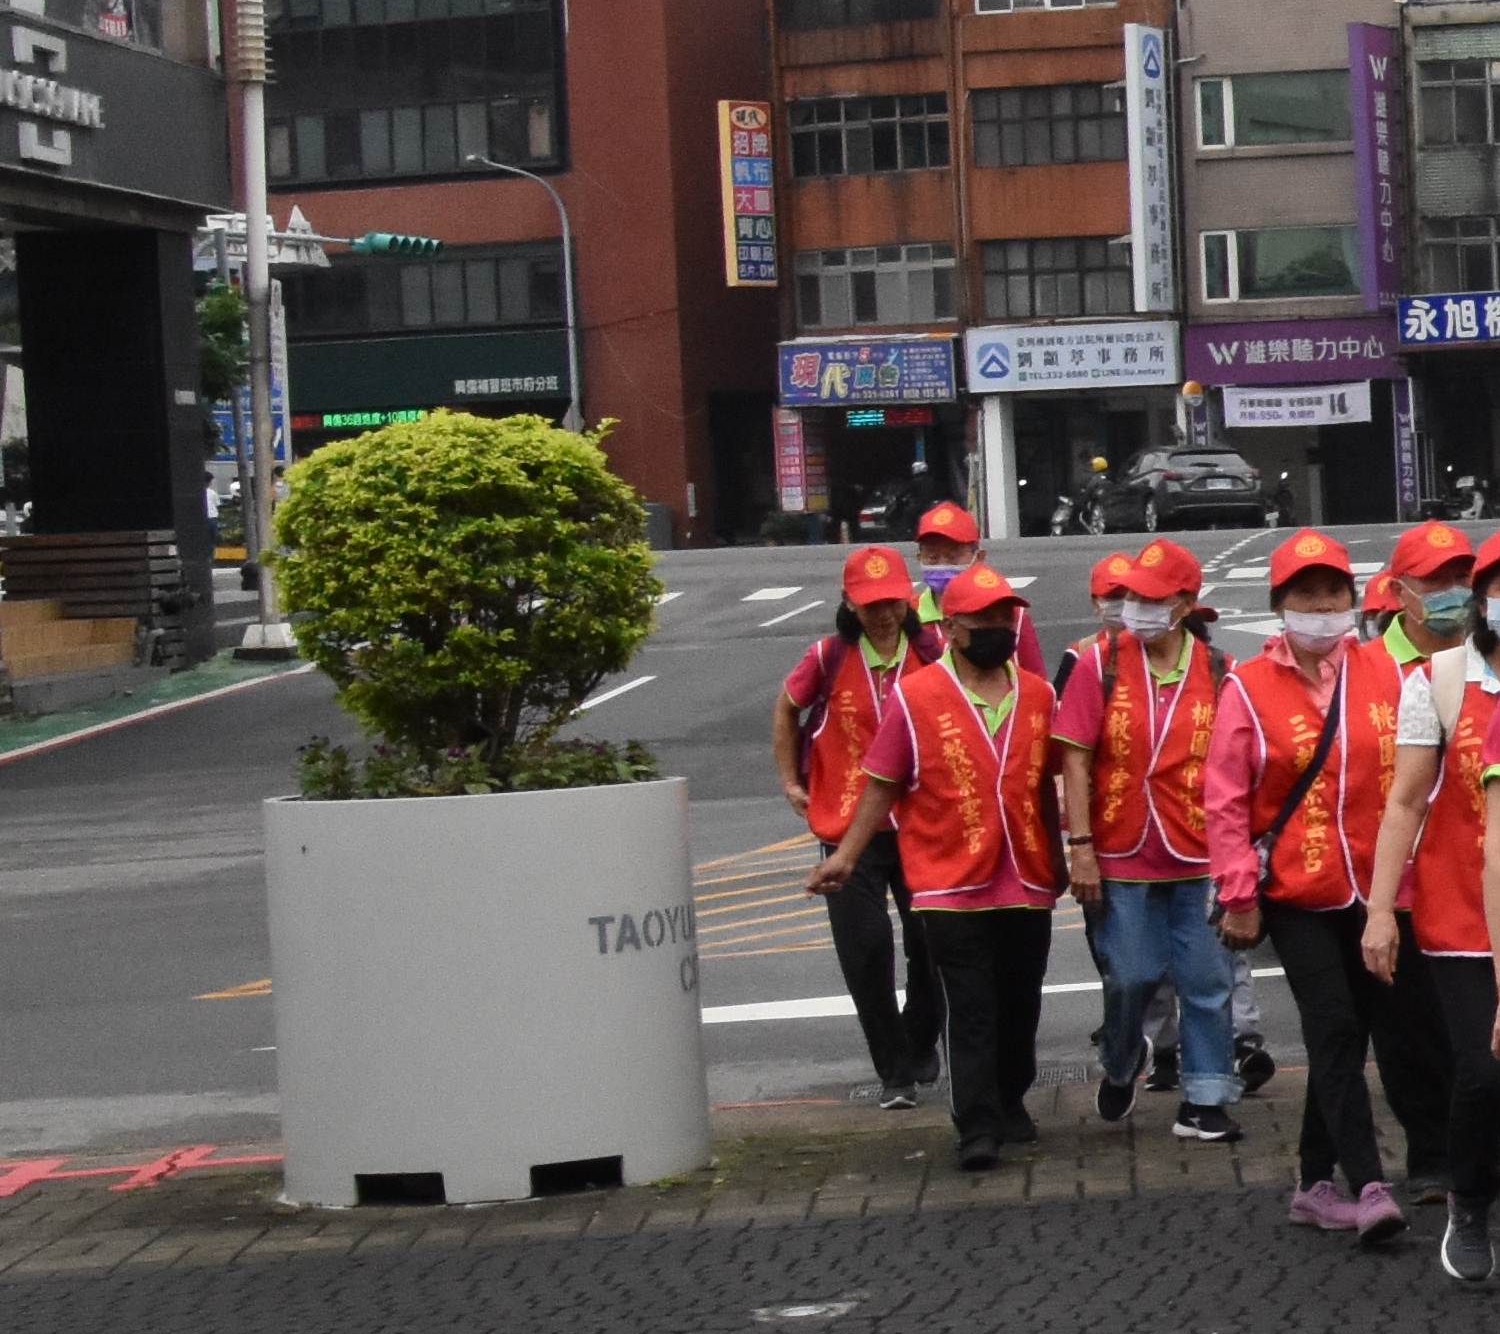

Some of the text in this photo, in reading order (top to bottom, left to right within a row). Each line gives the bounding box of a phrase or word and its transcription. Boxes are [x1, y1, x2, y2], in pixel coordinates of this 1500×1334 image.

[733, 131, 769, 156] 招牌
[734, 161, 770, 183] 帆布
[587, 903, 697, 955] TAOYU
